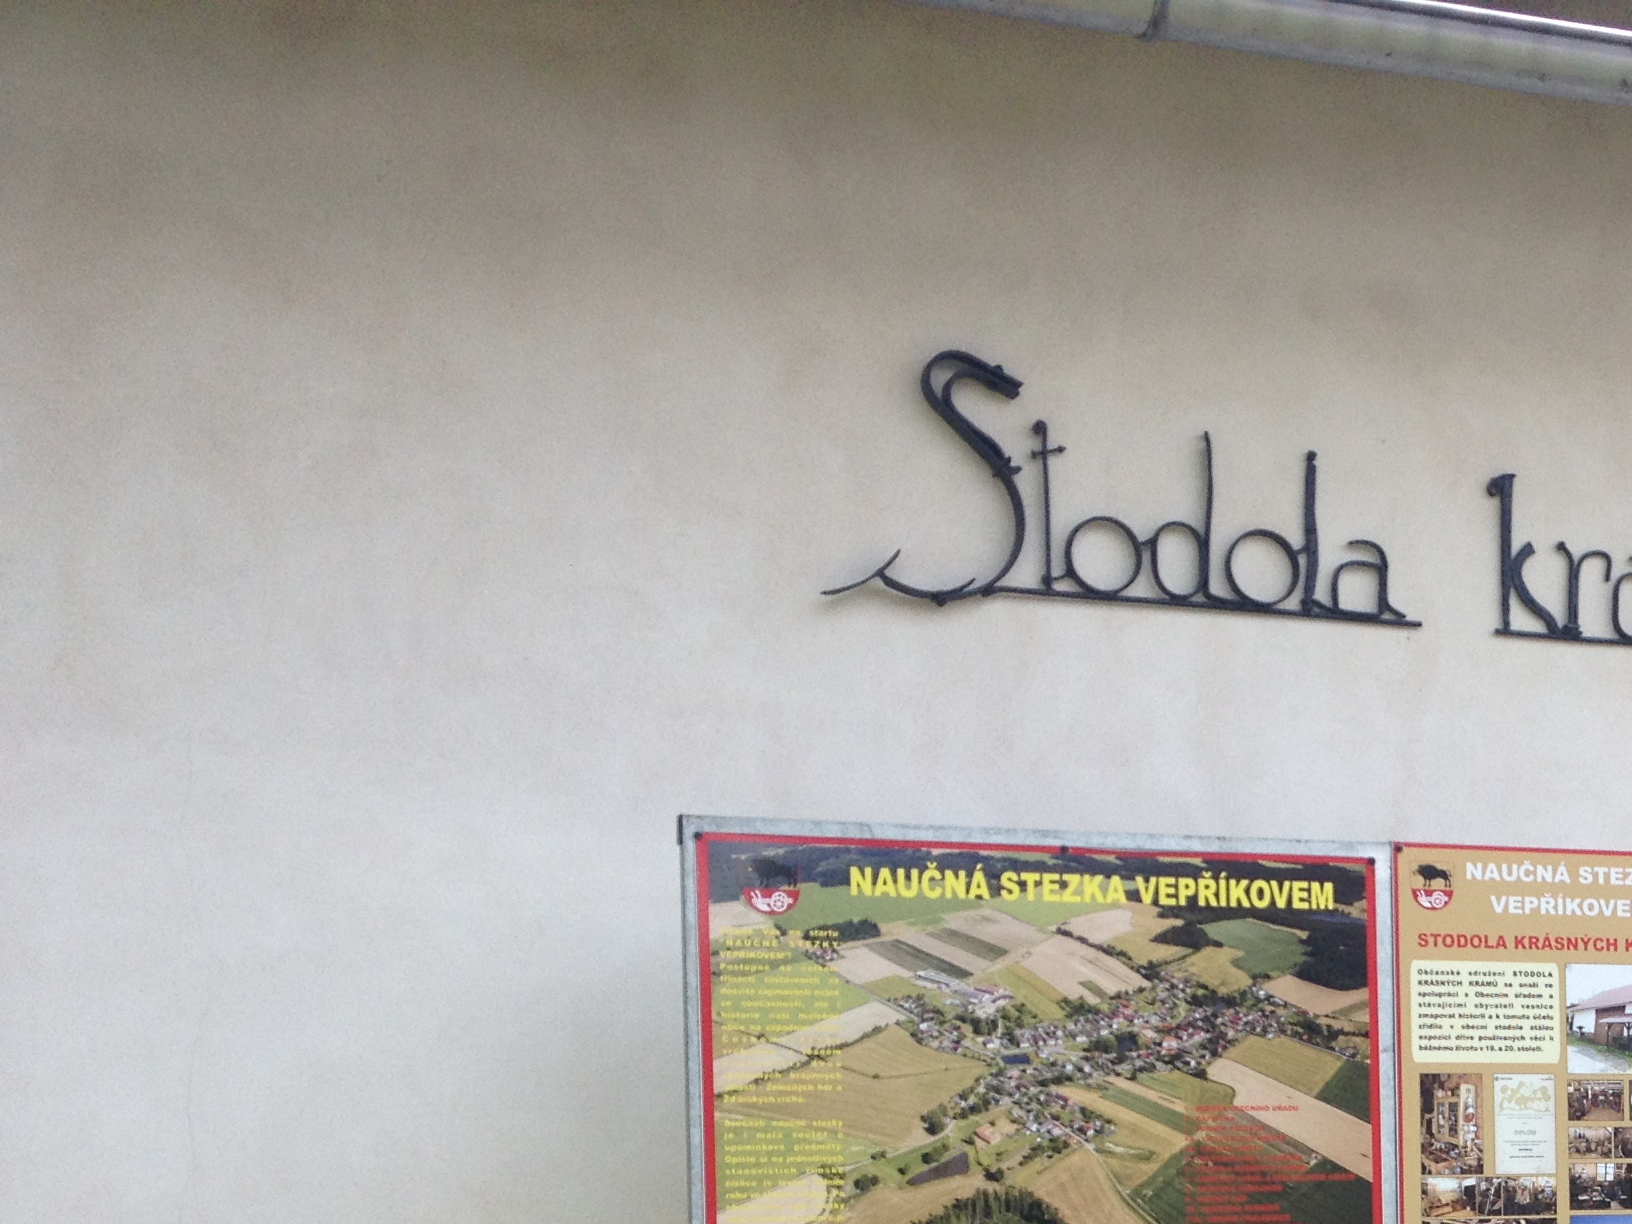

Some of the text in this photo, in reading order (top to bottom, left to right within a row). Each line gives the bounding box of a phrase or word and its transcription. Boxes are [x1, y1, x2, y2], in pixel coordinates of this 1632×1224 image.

[822, 350, 1420, 626] Stodola
[849, 862, 1335, 909] NAUČNÁ STEZKA VEPŘÍKOVEM
[1465, 860, 1571, 883] NAUČNÁ
[1417, 933, 1507, 950] STODOLA
[1514, 933, 1618, 952] KRÁSNÝCH
